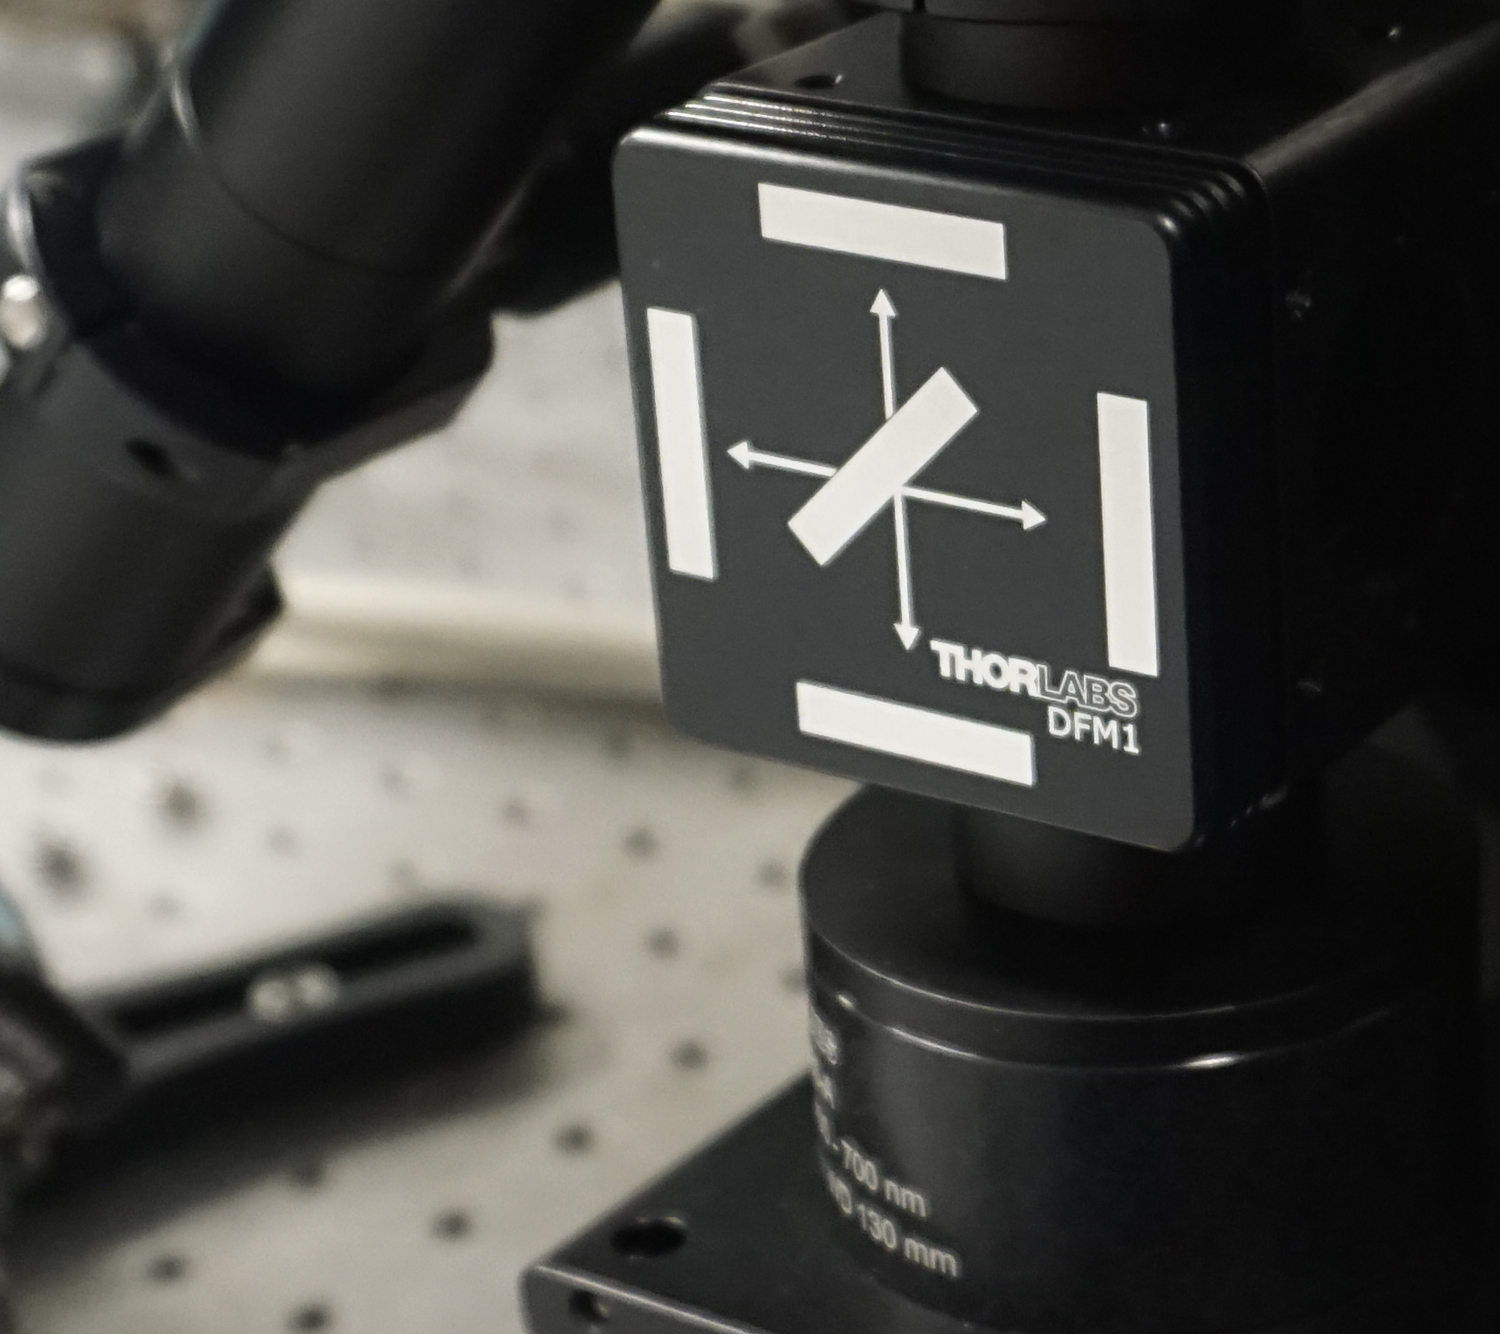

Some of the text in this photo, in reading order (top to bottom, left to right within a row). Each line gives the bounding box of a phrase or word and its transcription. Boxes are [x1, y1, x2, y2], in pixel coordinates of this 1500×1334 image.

[929, 638, 1138, 718] THORLABS
[1048, 705, 1141, 756] DFM1
[884, 1178, 928, 1218] nm
[857, 1203, 898, 1251] 130
[903, 1236, 959, 1279] mm
